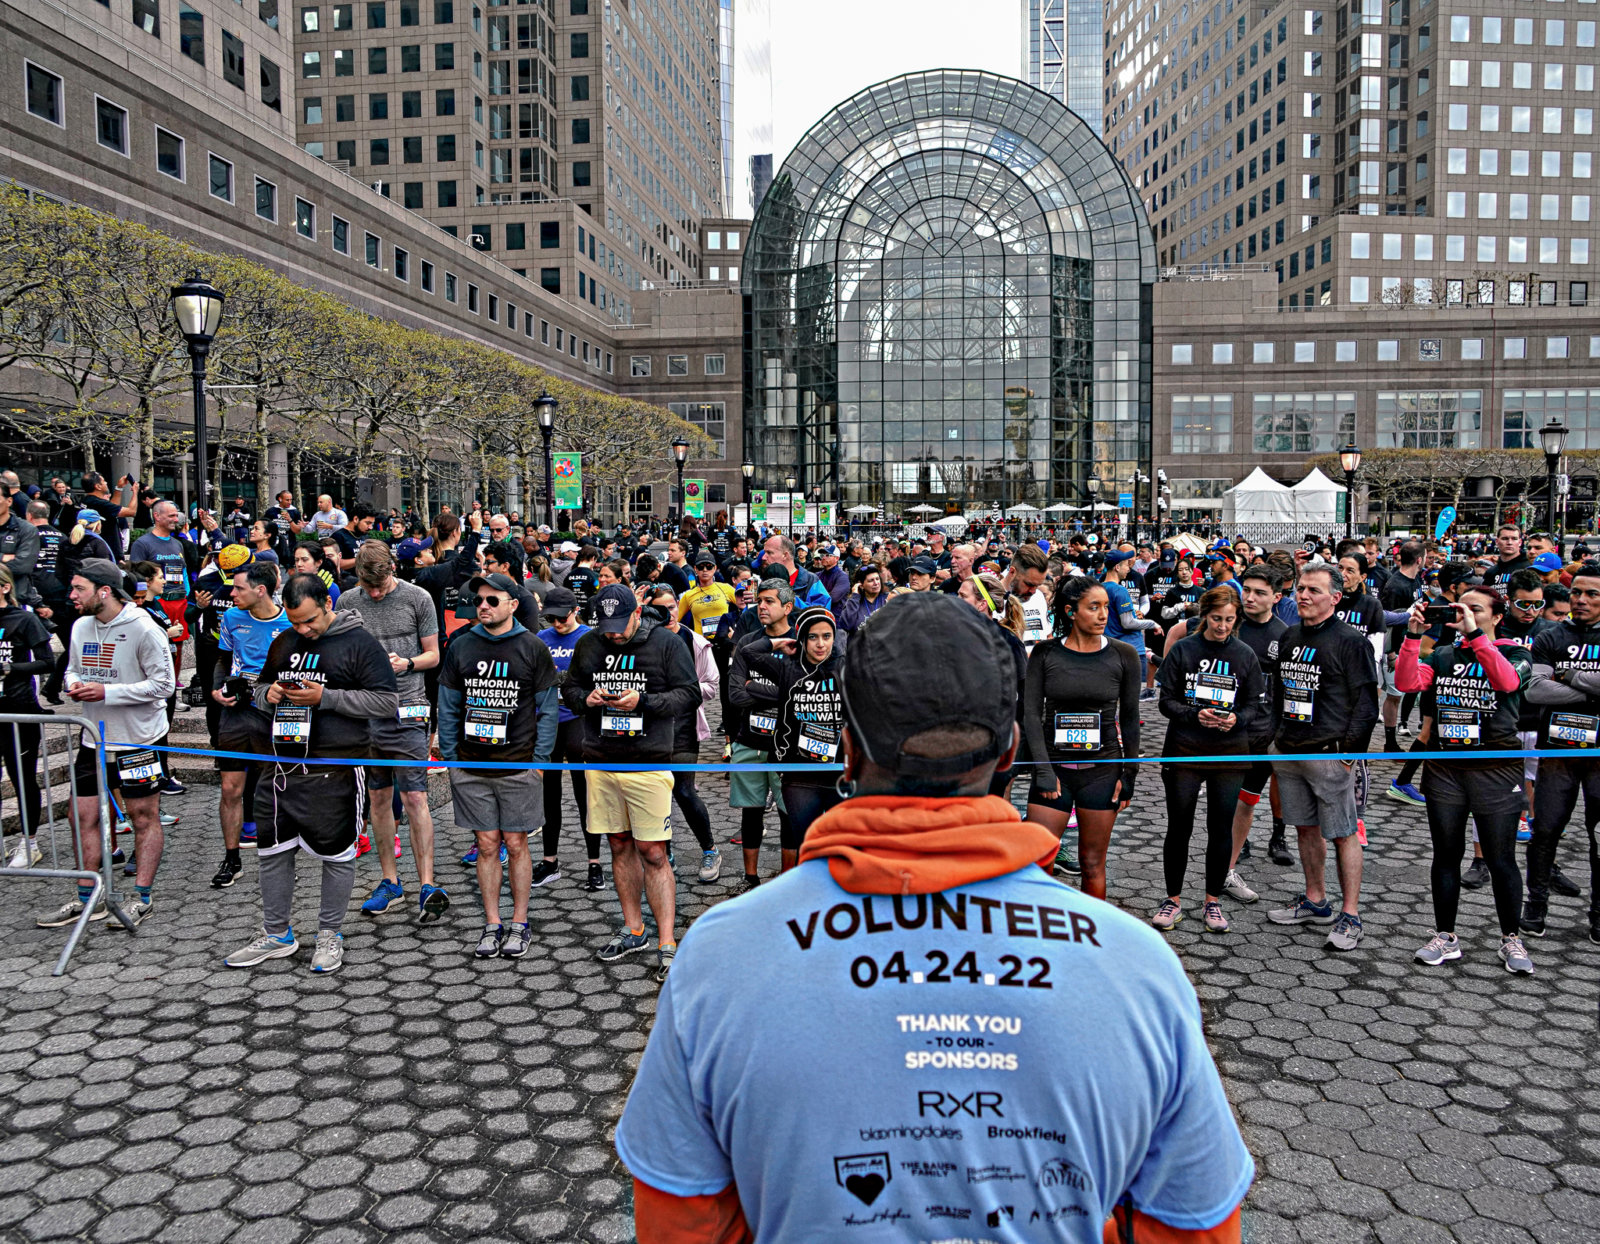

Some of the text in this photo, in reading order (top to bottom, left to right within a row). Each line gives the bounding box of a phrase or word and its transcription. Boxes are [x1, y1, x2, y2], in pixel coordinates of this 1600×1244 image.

[1158, 576, 1173, 584] 9/11
[601, 598, 620, 607] NYPD
[1336, 610, 1361, 625] 9/11
[1291, 645, 1316, 662] 9/11
[1567, 643, 1600, 660] 9/11
[289, 652, 320, 671] 9/11
[605, 654, 636, 671] 9/11
[1199, 658, 1229, 675] 9/11
[1280, 661, 1322, 674] MEMORIAL
[1555, 661, 1600, 670] MEMORIA
[476, 660, 509, 678] 9/11
[1453, 662, 1484, 678] 9/11
[277, 671, 328, 683] MEMORIAL
[592, 672, 648, 682] MEMORIAL
[1436, 676, 1493, 689] MEMORIA
[464, 679, 521, 690] MEMORIAL
[804, 678, 835, 693] 9/11
[793, 693, 842, 703] MEMORIA
[1211, 688, 1223, 701] 10
[1443, 687, 1496, 700] MUSEUM
[611, 717, 631, 730] 955
[795, 712, 842, 721] RUNWAL
[279, 723, 300, 735] 1805
[474, 723, 495, 738] 954
[755, 717, 776, 731] 1470
[1442, 724, 1469, 738] 2395
[1066, 729, 1087, 743] 628
[1558, 726, 1587, 742] 2396
[806, 738, 830, 755] 1258
[128, 765, 155, 779] 1261
[786, 892, 1103, 951] VOLUNTEER
[850, 949, 1053, 990] 04.24.22
[896, 1015, 1022, 1035] THANK YOU
[936, 1037, 985, 1048] TO OUR
[904, 1051, 1019, 1070] SPONSORS
[917, 1090, 1005, 1118] RXR
[987, 1125, 1067, 1145] Brookfield
[900, 1161, 920, 1170] THE
[911, 1169, 949, 1178] FAMILY
